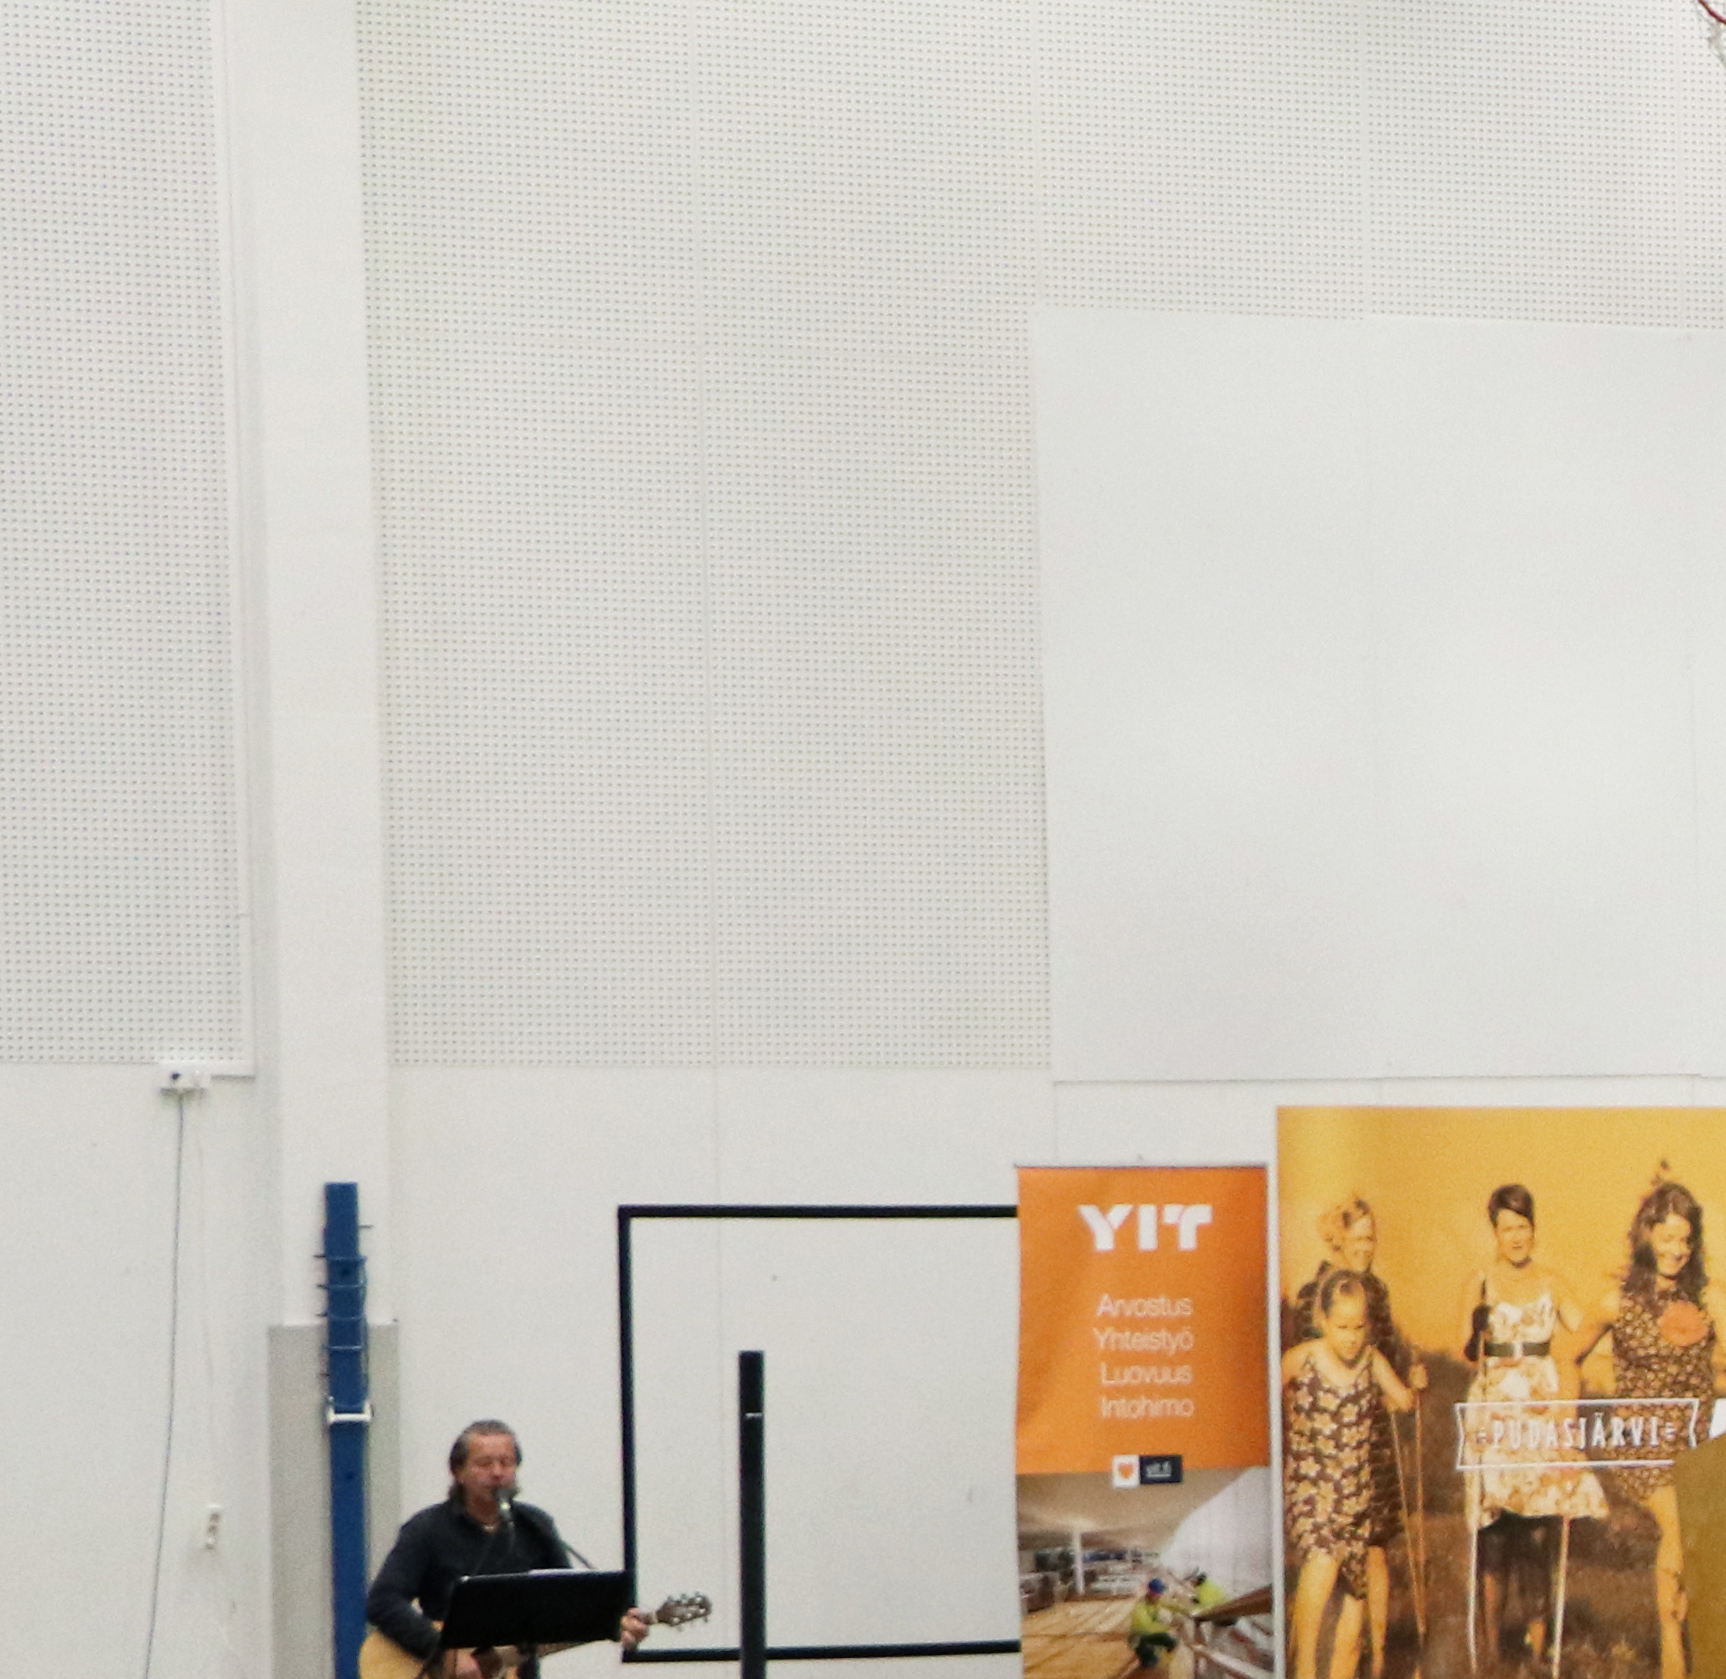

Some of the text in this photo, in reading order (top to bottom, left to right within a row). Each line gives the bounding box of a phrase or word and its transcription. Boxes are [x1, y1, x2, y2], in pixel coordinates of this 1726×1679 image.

[1077, 1203, 1213, 1251] YIT
[1097, 1293, 1194, 1318] Arvostus
[1093, 1326, 1195, 1356] Yhteistyö
[1100, 1361, 1193, 1385] Luovuus
[1101, 1396, 1195, 1419] Intohimo
[1491, 1411, 1660, 1450] PUDASJÄRVI
